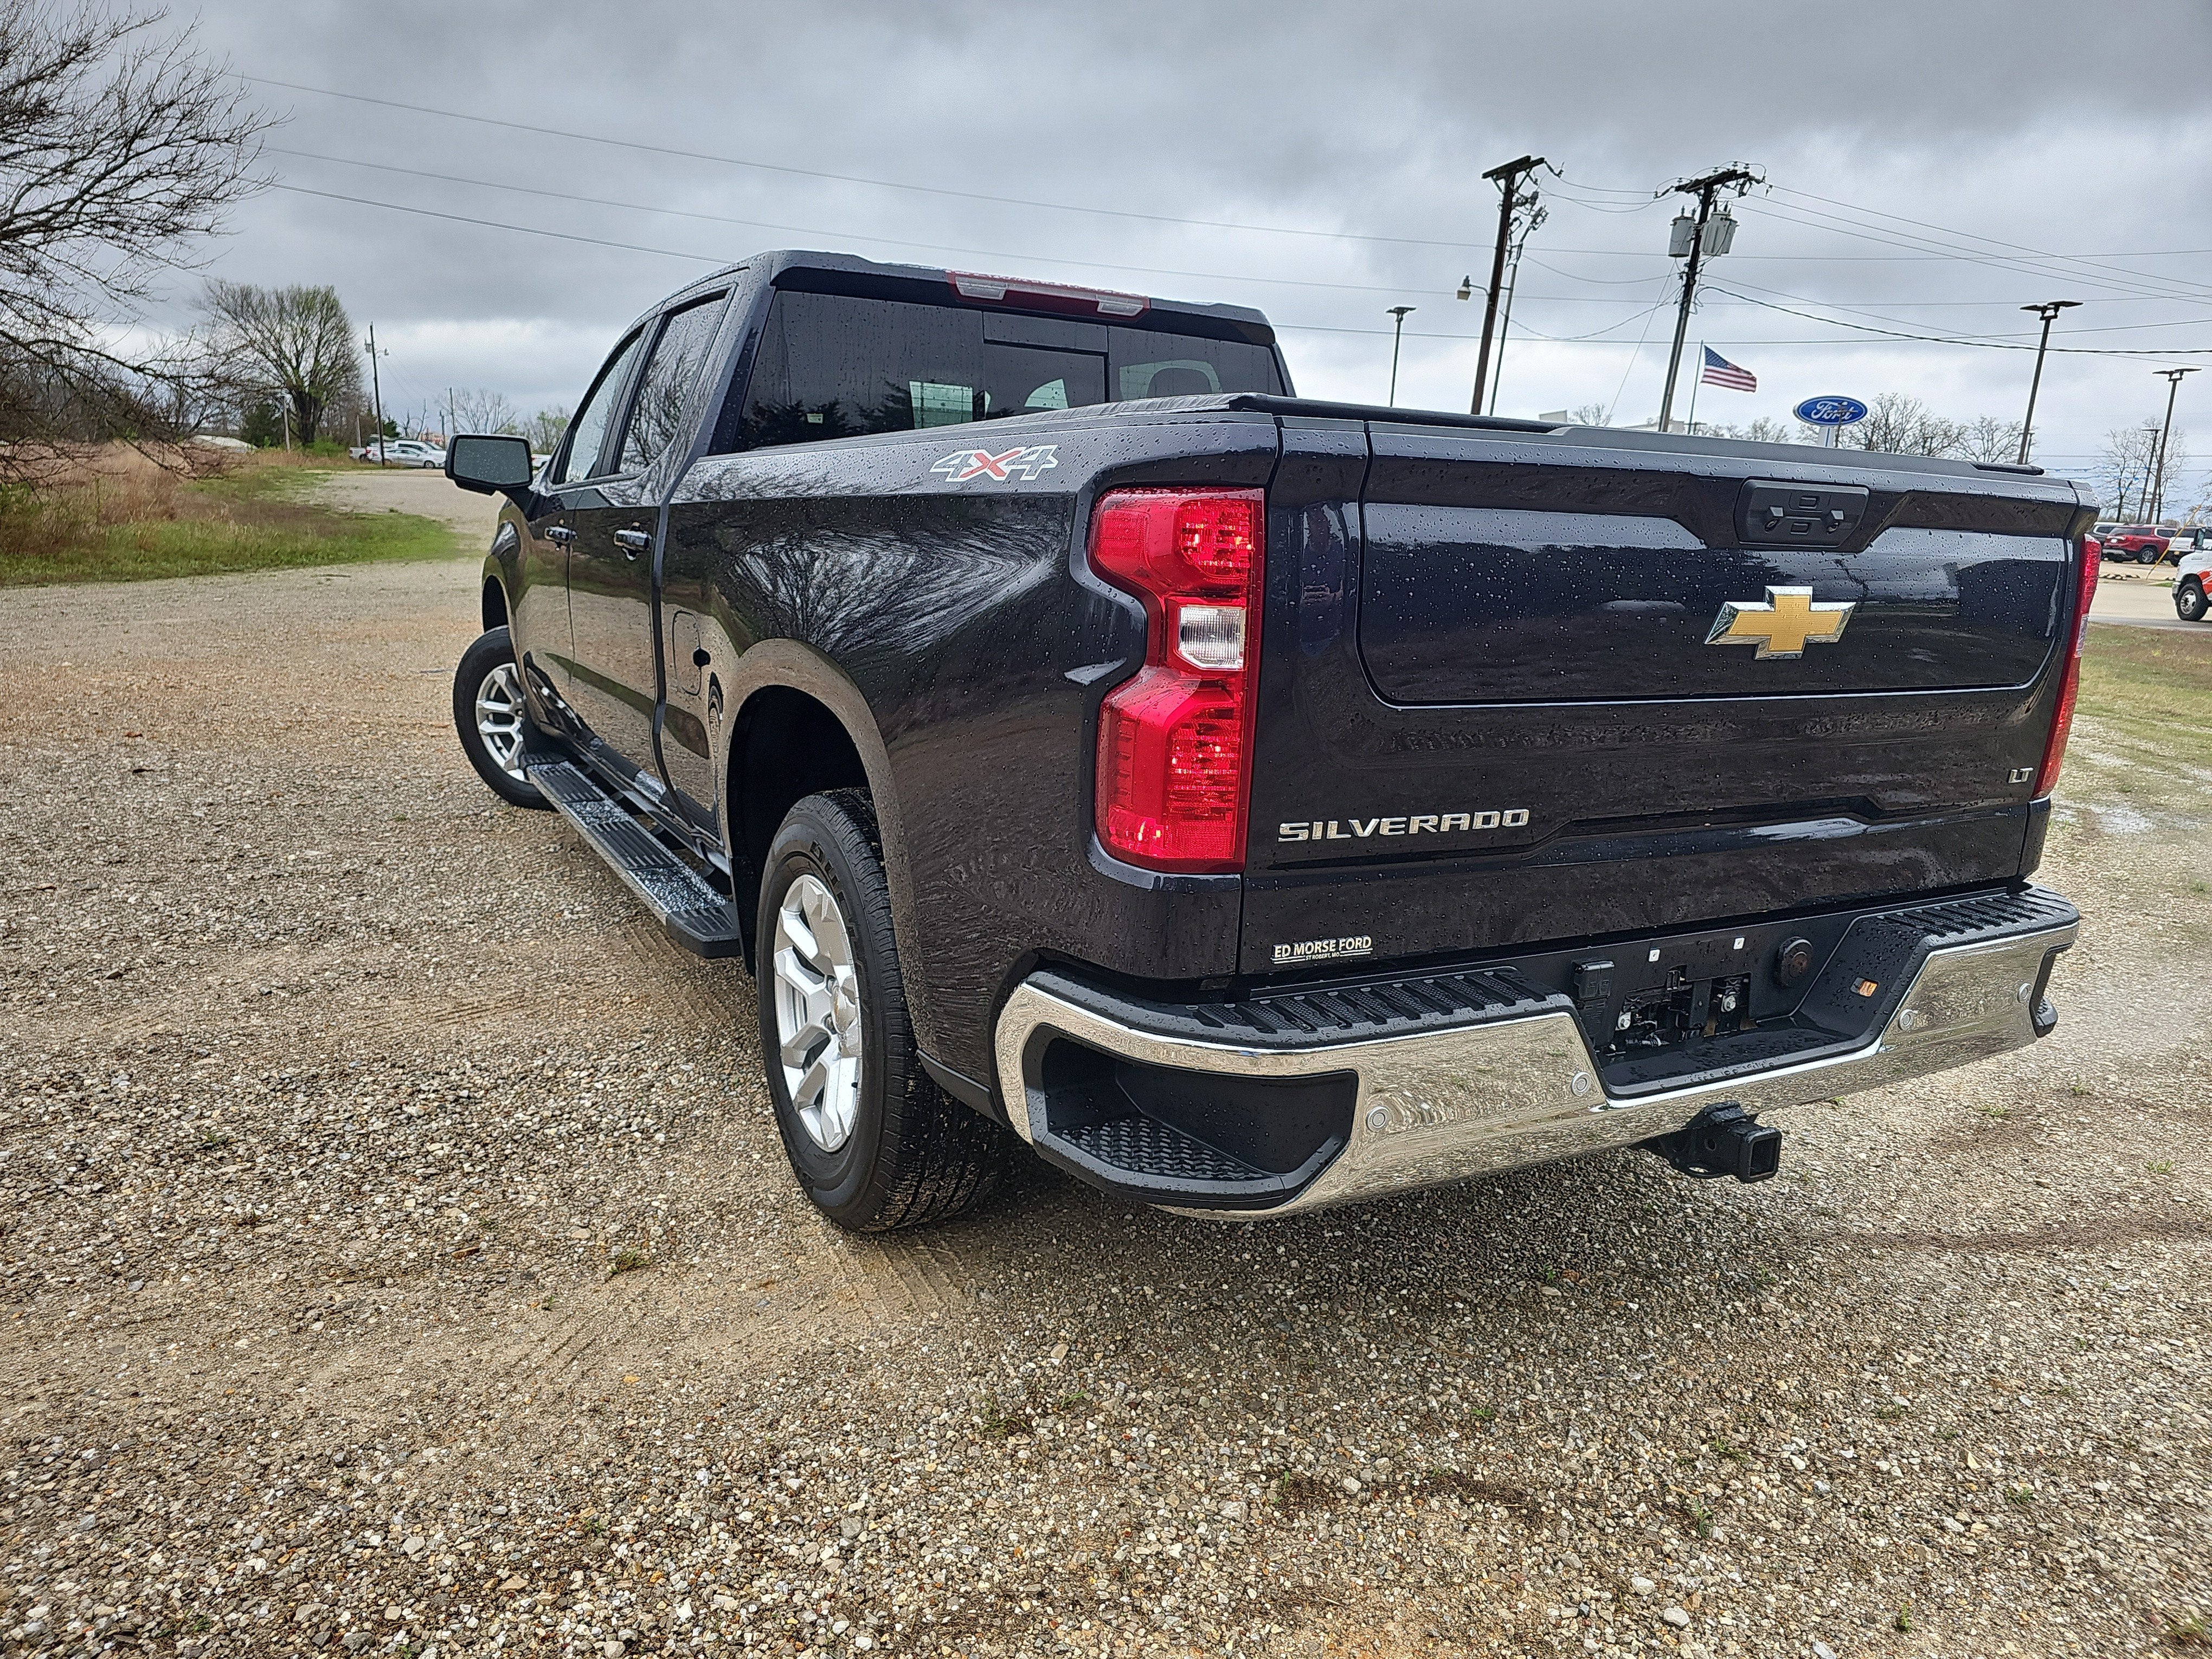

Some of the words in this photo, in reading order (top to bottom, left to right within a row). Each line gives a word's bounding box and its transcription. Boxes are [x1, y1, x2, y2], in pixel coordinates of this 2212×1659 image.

[2008, 767, 2034, 784] LT
[1278, 808, 1531, 842] SILVERADO
[1274, 944, 1291, 958] ED
[1293, 939, 1337, 956] MORSE
[1338, 935, 1372, 951] FORD
